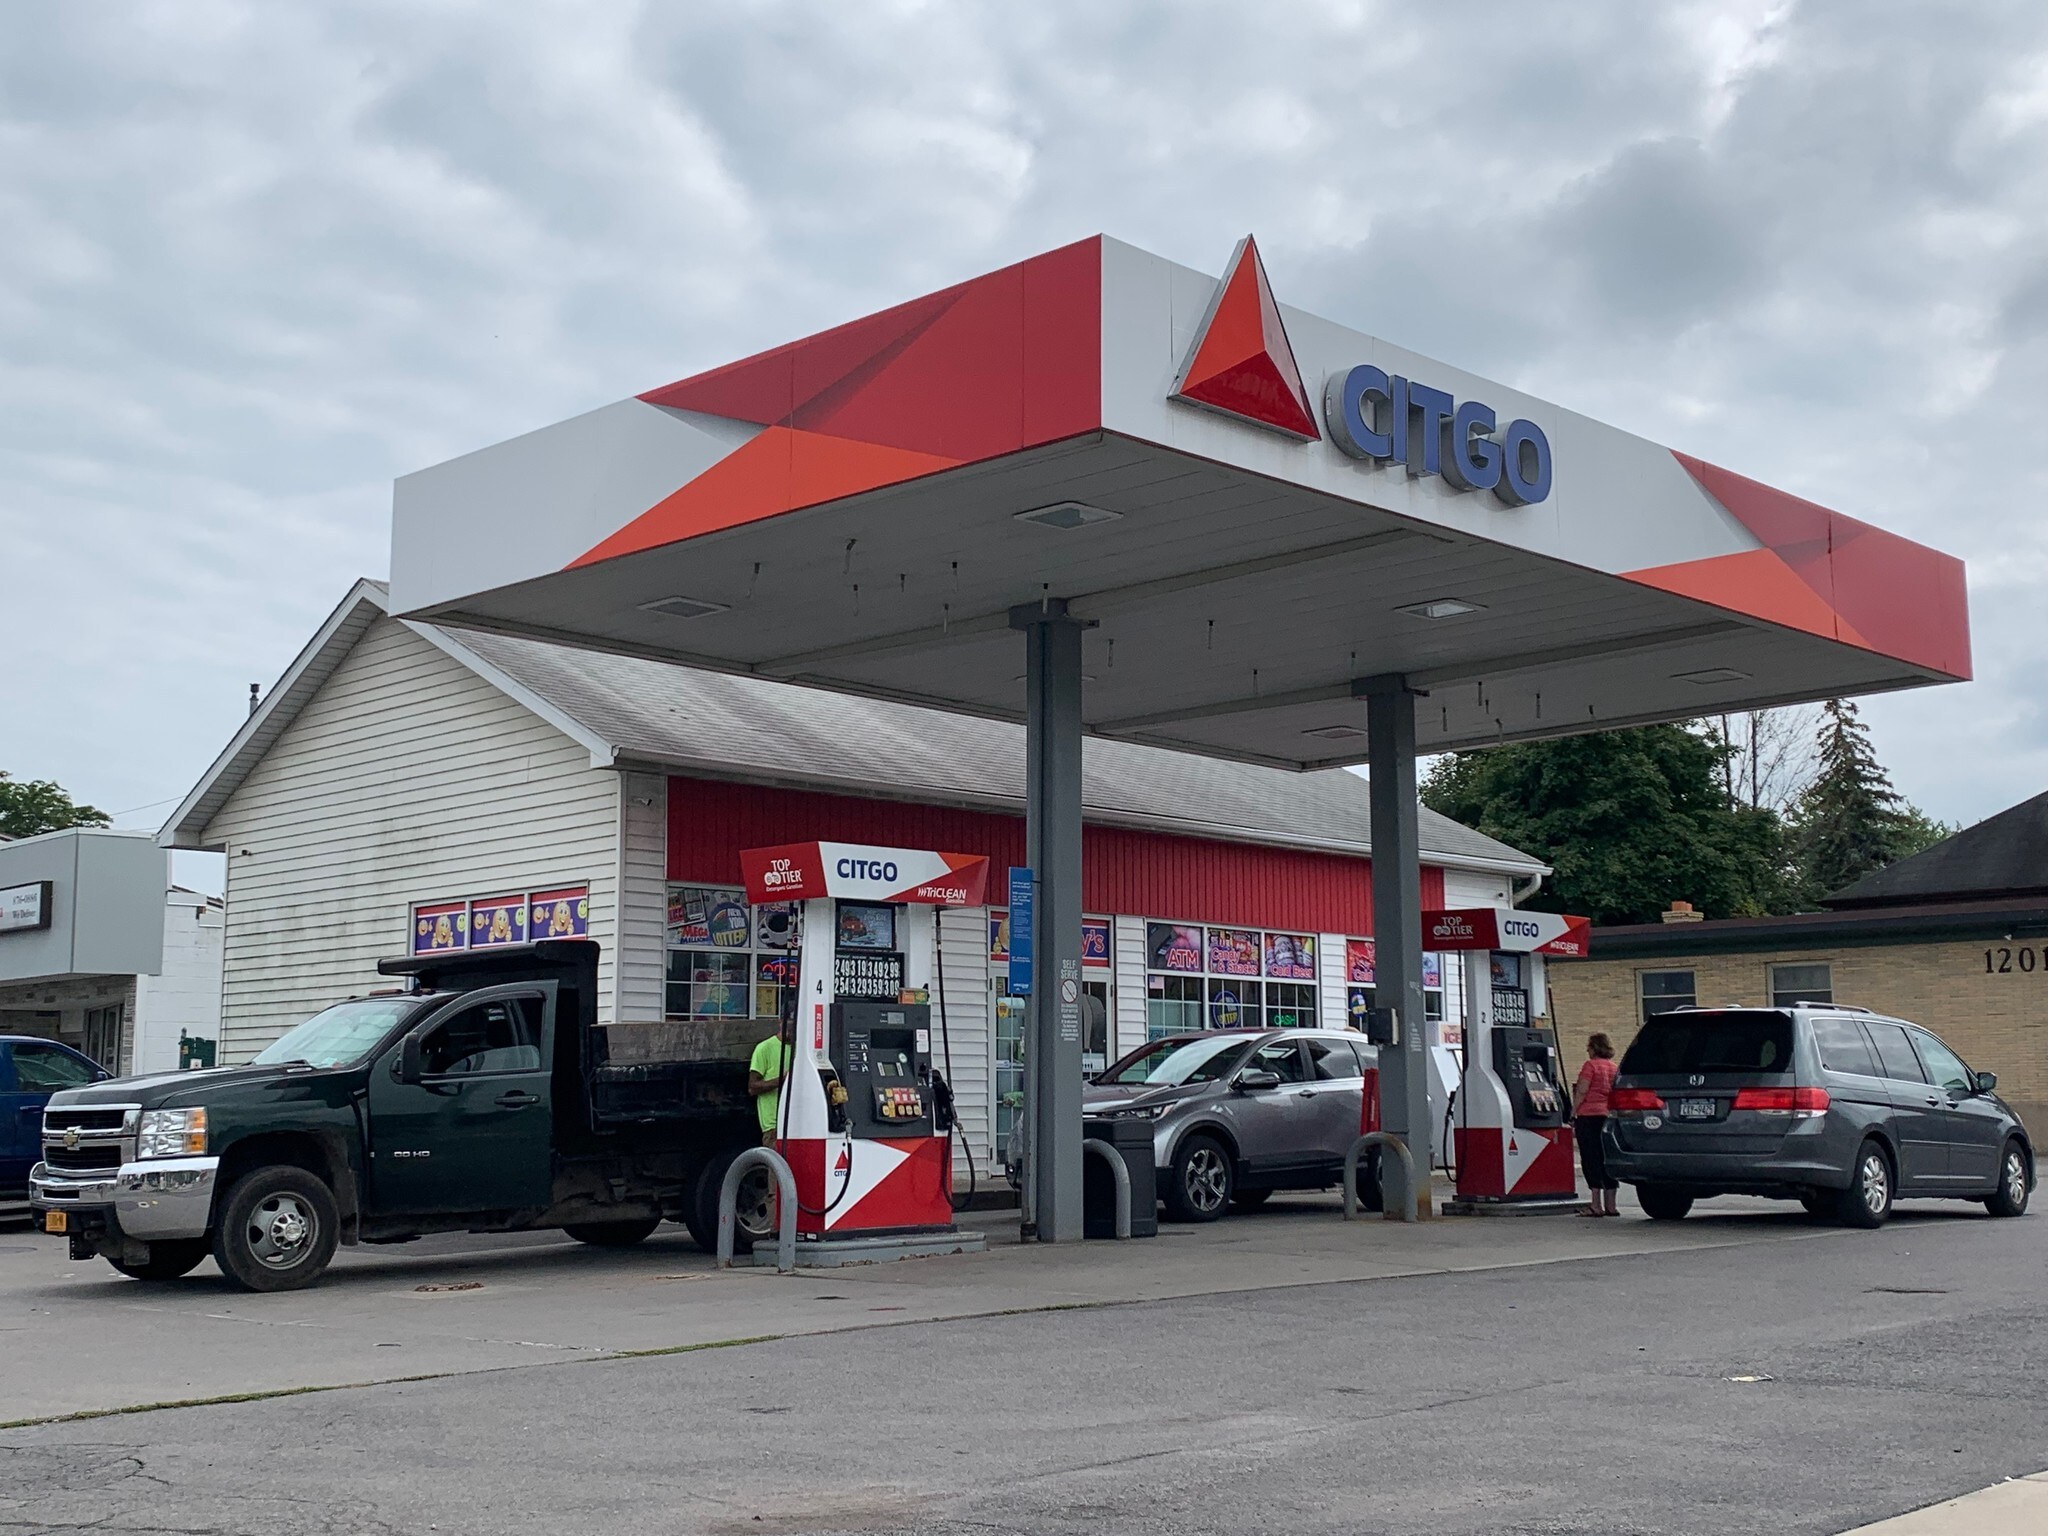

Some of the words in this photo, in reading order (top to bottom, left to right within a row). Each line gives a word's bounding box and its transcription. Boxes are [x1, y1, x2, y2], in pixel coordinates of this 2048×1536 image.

[1340, 364, 1552, 505] CITGO
[770, 859, 790, 872] TOP
[837, 858, 898, 882] CITGO
[781, 869, 801, 883] TIER
[1441, 916, 1463, 925] TOP
[682, 925, 709, 937] MEGA
[1450, 925, 1473, 935] TIER
[1504, 920, 1539, 938] CITGO
[1167, 948, 1199, 968] ATM
[1212, 947, 1240, 965] Candy
[1062, 959, 1077, 970] SELF
[1218, 963, 1225, 973] &
[1228, 963, 1258, 976] Snacks
[1271, 964, 1290, 977] Cold
[1292, 966, 1313, 978] Beer
[1060, 969, 1078, 980] SERVE
[816, 979, 823, 994] 4
[1274, 1014, 1296, 1026] CASH
[1444, 1032, 1462, 1044] ICE
